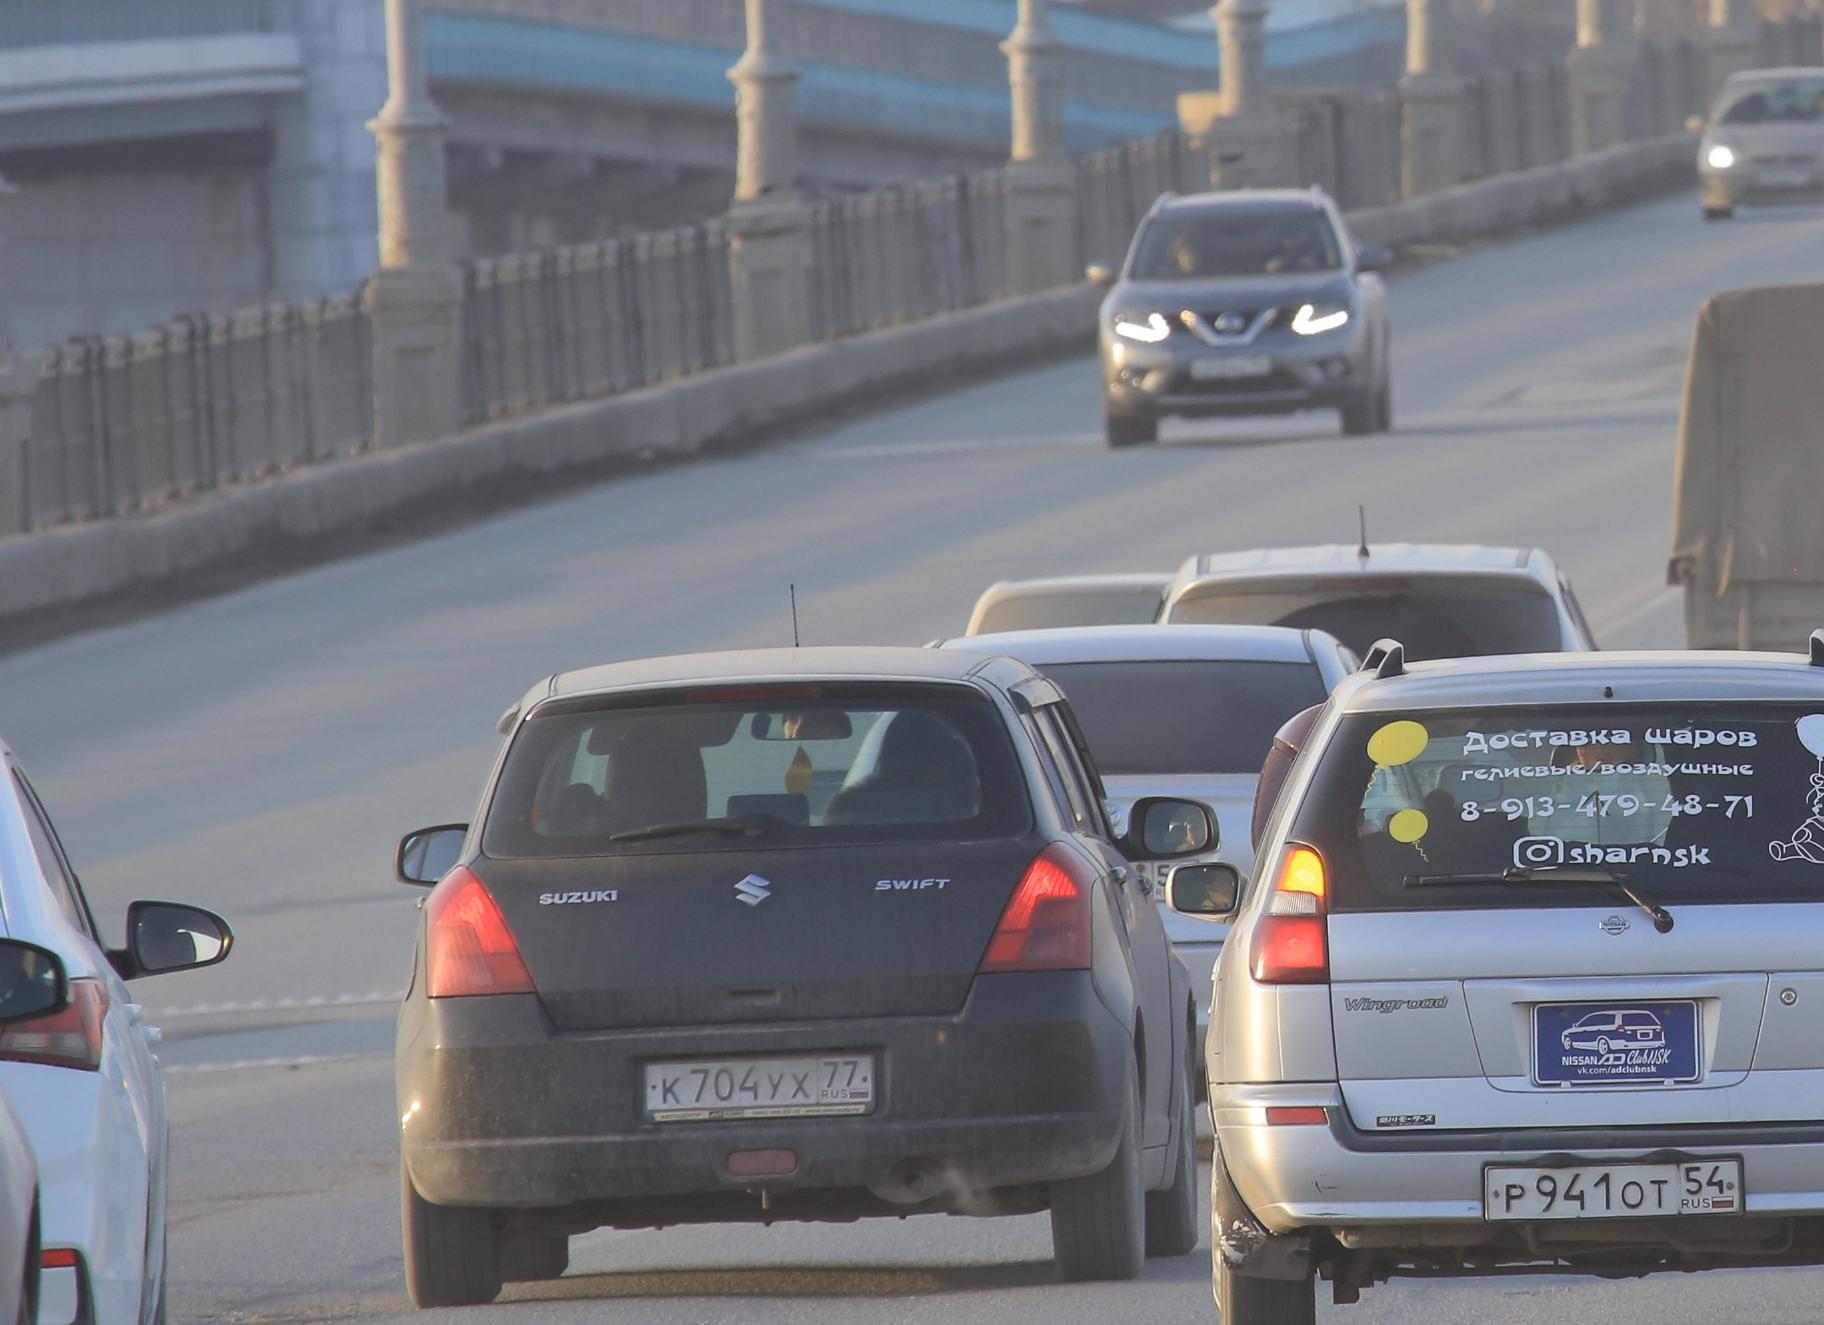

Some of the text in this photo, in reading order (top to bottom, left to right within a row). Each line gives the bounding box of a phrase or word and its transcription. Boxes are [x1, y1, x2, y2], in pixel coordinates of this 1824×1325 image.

[1644, 727, 1758, 749] шаров
[1460, 794, 1755, 822] 8-913-479-48-71
[1568, 843, 1712, 867] sharnsk
[874, 878, 951, 891] SWIFT
[538, 889, 619, 905] SUZUKI
[1344, 995, 1449, 1014] Wingroad
[1561, 1056, 1598, 1066] NISSAN
[823, 1060, 859, 1088] 77
[1577, 1065, 1657, 1075] vk.com/adclubnsk
[820, 1088, 848, 1099] RUS
[1684, 1165, 1725, 1195] 54
[1681, 1198, 1711, 1209] RUS
